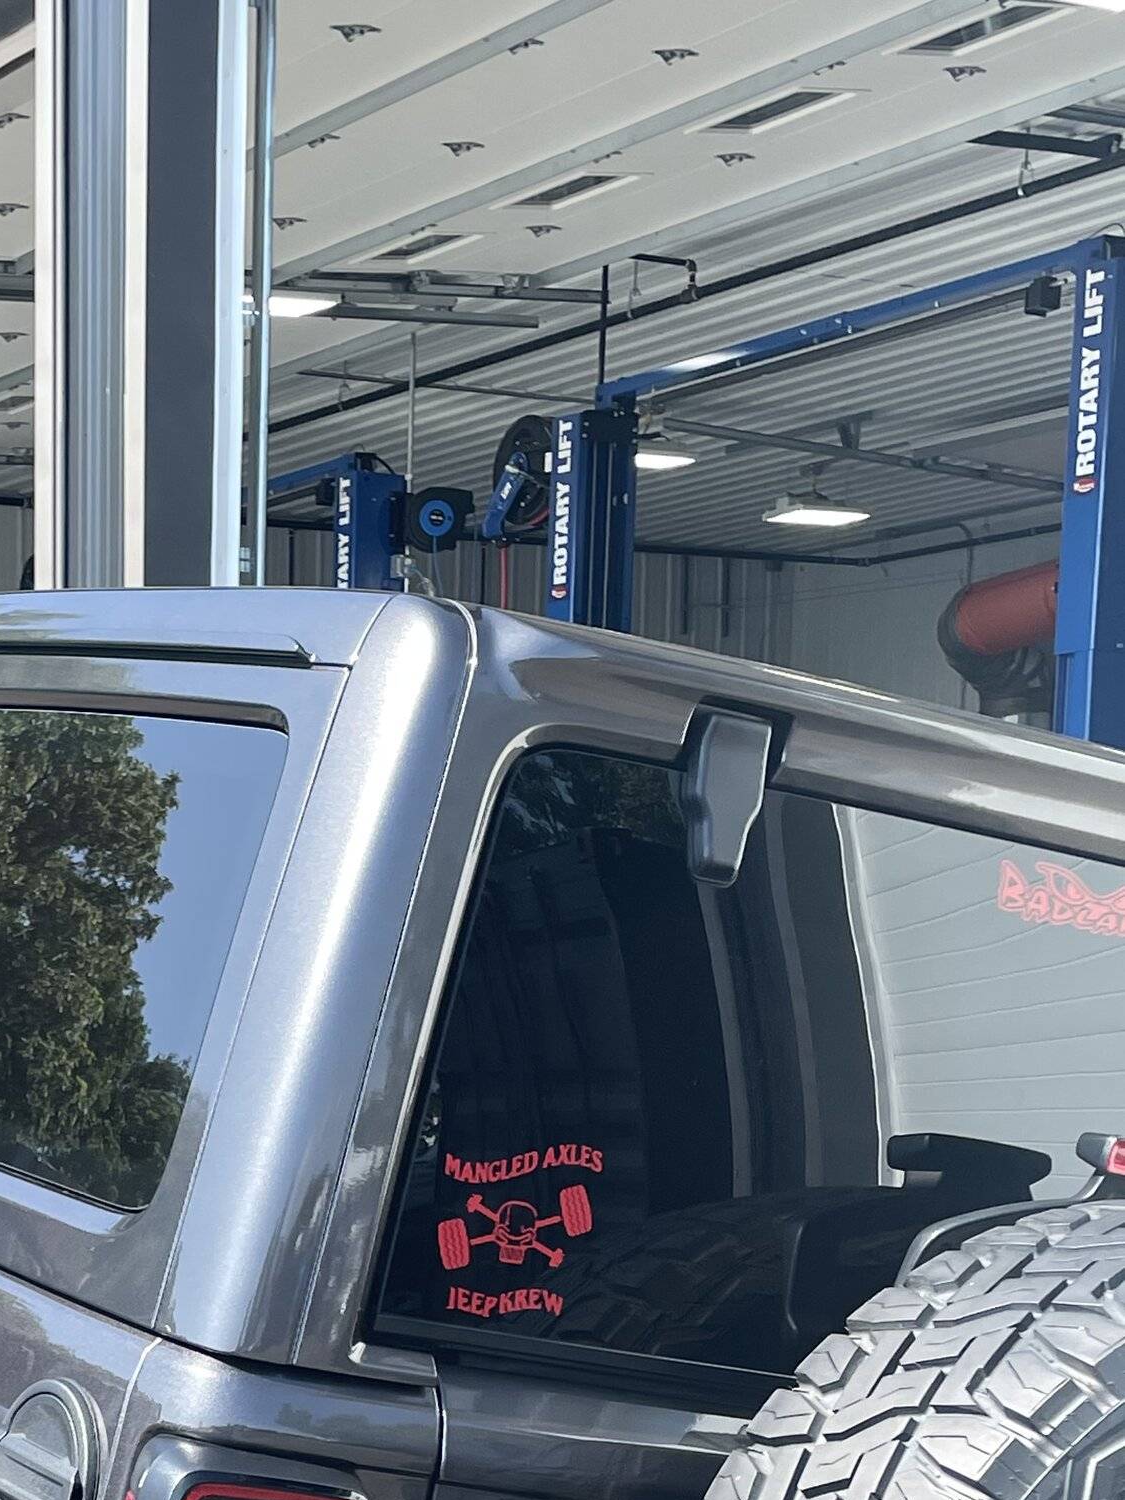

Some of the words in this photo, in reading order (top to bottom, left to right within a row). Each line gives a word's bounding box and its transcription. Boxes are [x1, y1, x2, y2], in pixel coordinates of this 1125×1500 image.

[1082, 269, 1106, 338] LIFT
[1075, 347, 1101, 476] ROTARY
[557, 419, 573, 474] LIFT
[338, 477, 351, 526] LIFT
[552, 482, 571, 586] ROTARY
[444, 1150, 539, 1184] MANGLED
[542, 1144, 603, 1173] AXLES
[498, 1288, 564, 1317] KREW
